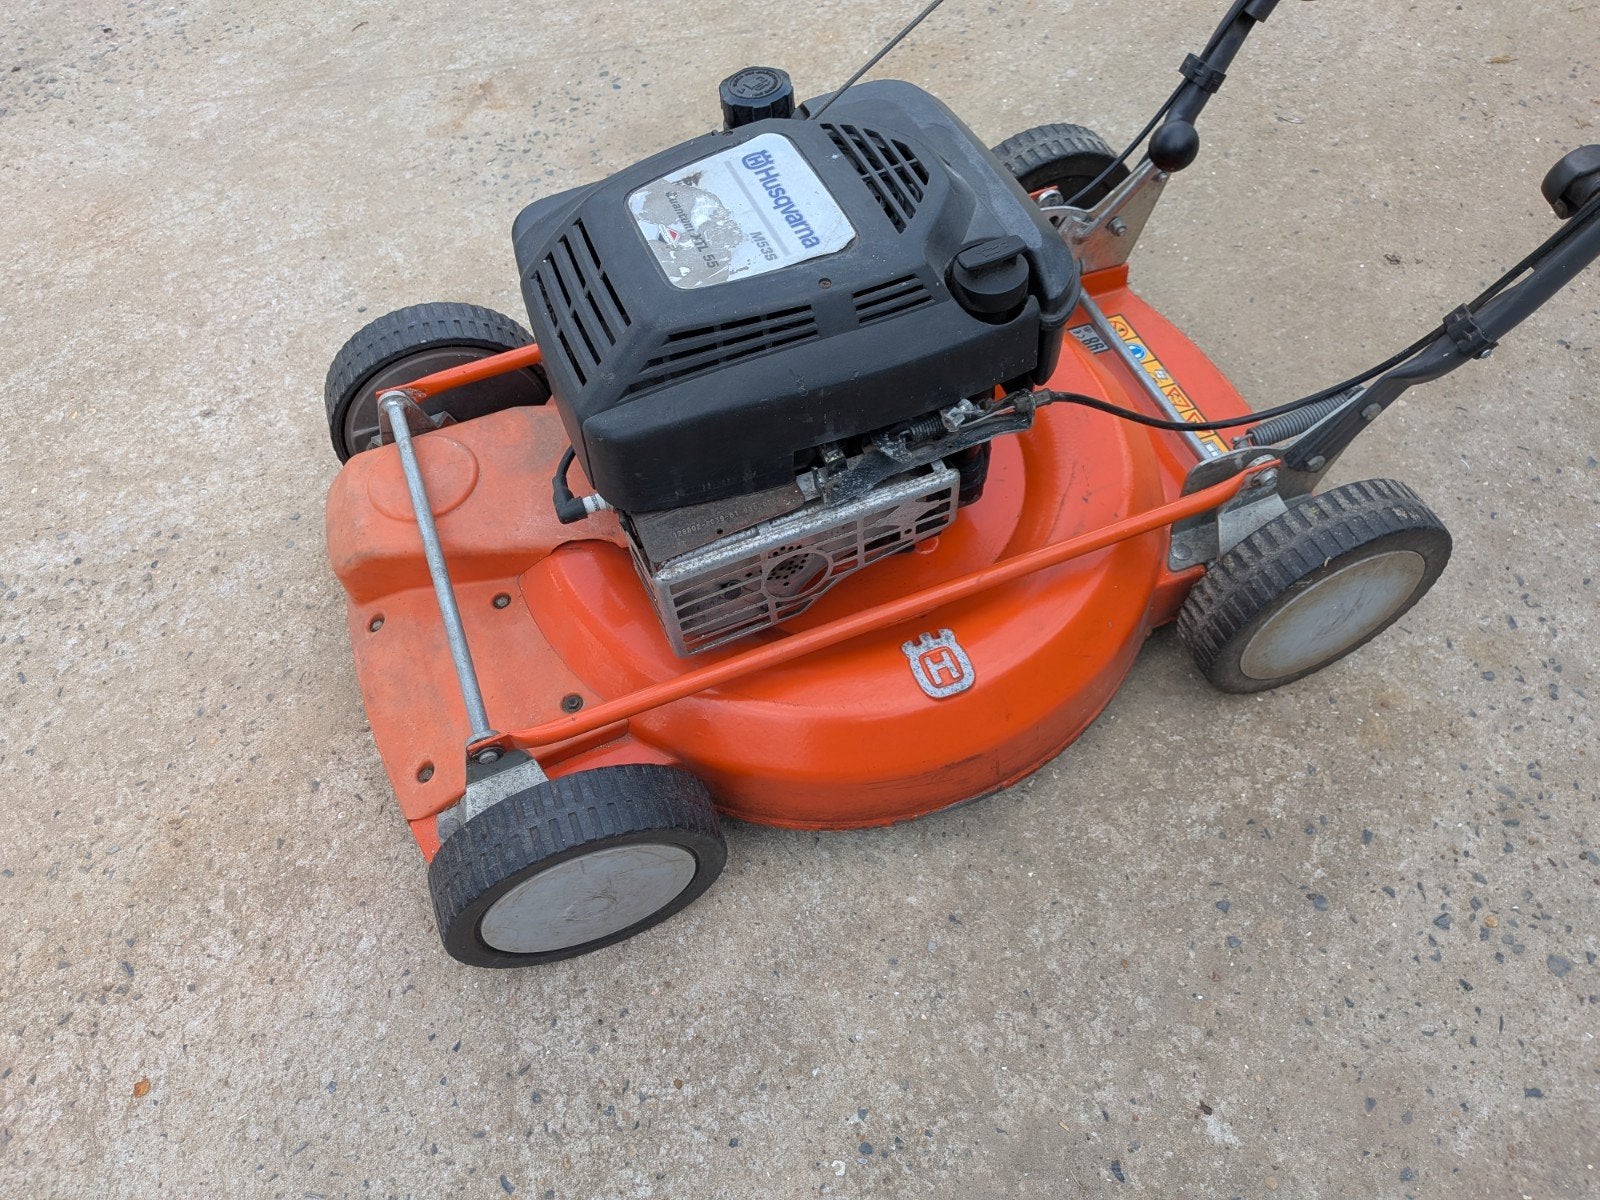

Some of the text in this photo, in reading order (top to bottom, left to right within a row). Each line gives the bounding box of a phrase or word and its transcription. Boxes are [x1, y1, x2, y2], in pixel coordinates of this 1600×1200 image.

[754, 166, 820, 249] Husqvarna
[702, 254, 720, 268] 55
[750, 231, 778, 261] M53S
